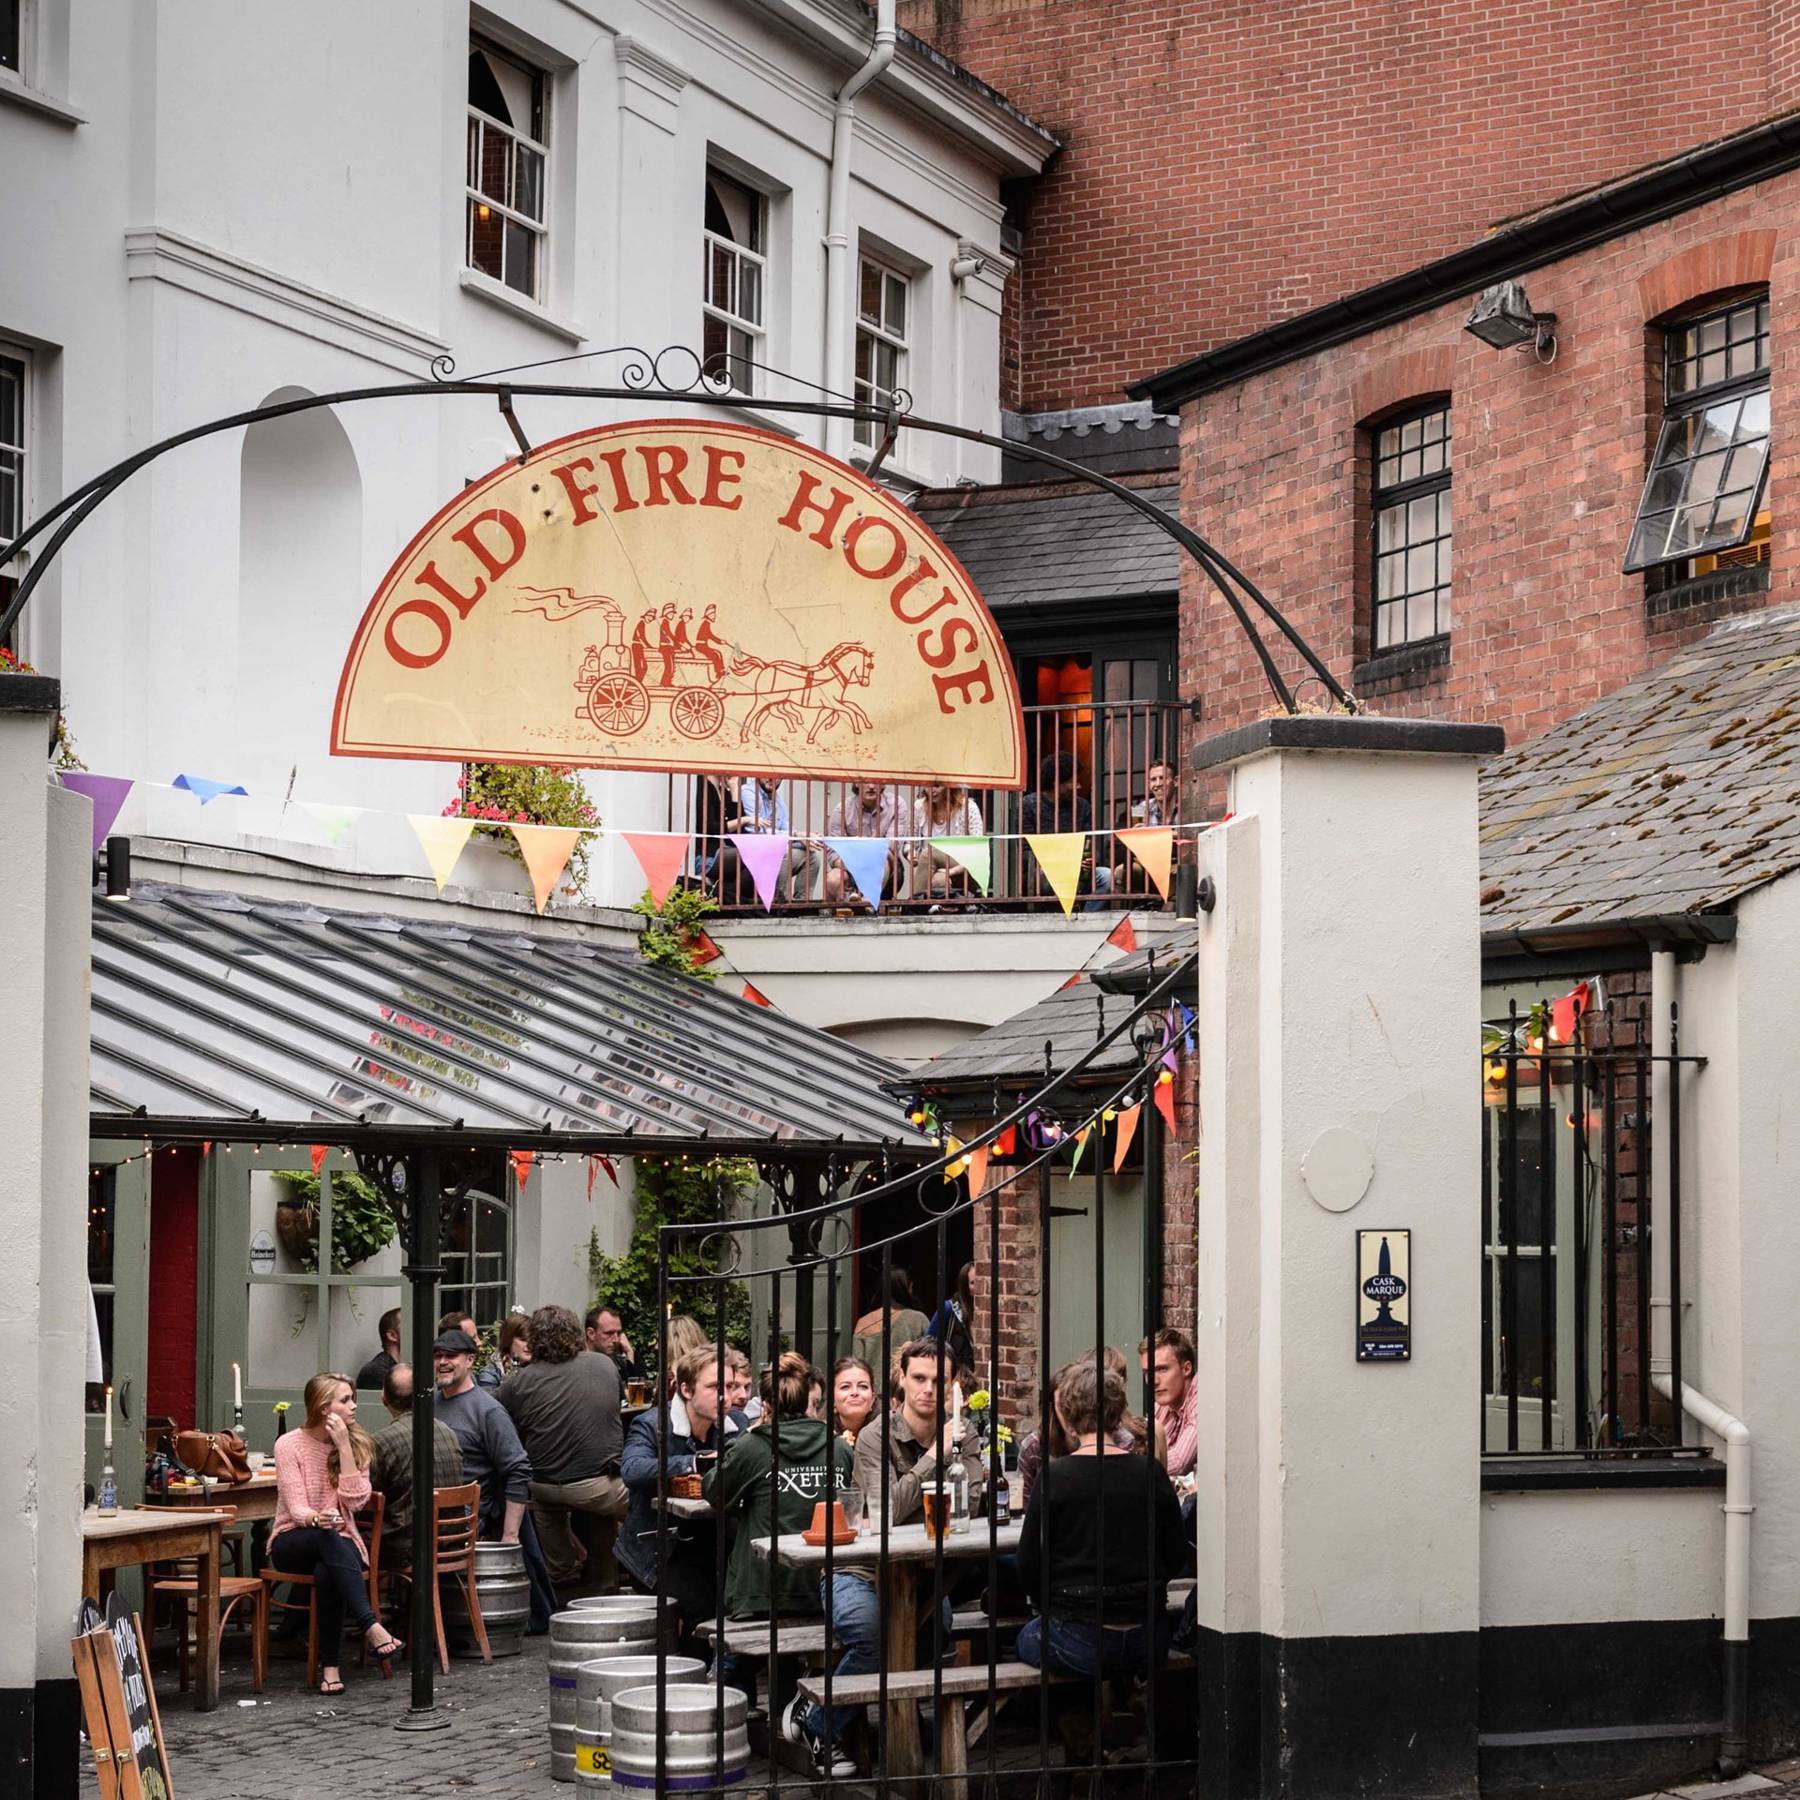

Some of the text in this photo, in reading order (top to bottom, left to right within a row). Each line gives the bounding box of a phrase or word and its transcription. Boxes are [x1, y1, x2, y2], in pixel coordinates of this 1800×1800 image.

[383, 444, 995, 715] OLD FIRE HOUSE
[1366, 1285, 1403, 1296] MARQUE
[1372, 1277, 1395, 1286] CASK
[765, 1470, 848, 1499] XETR
